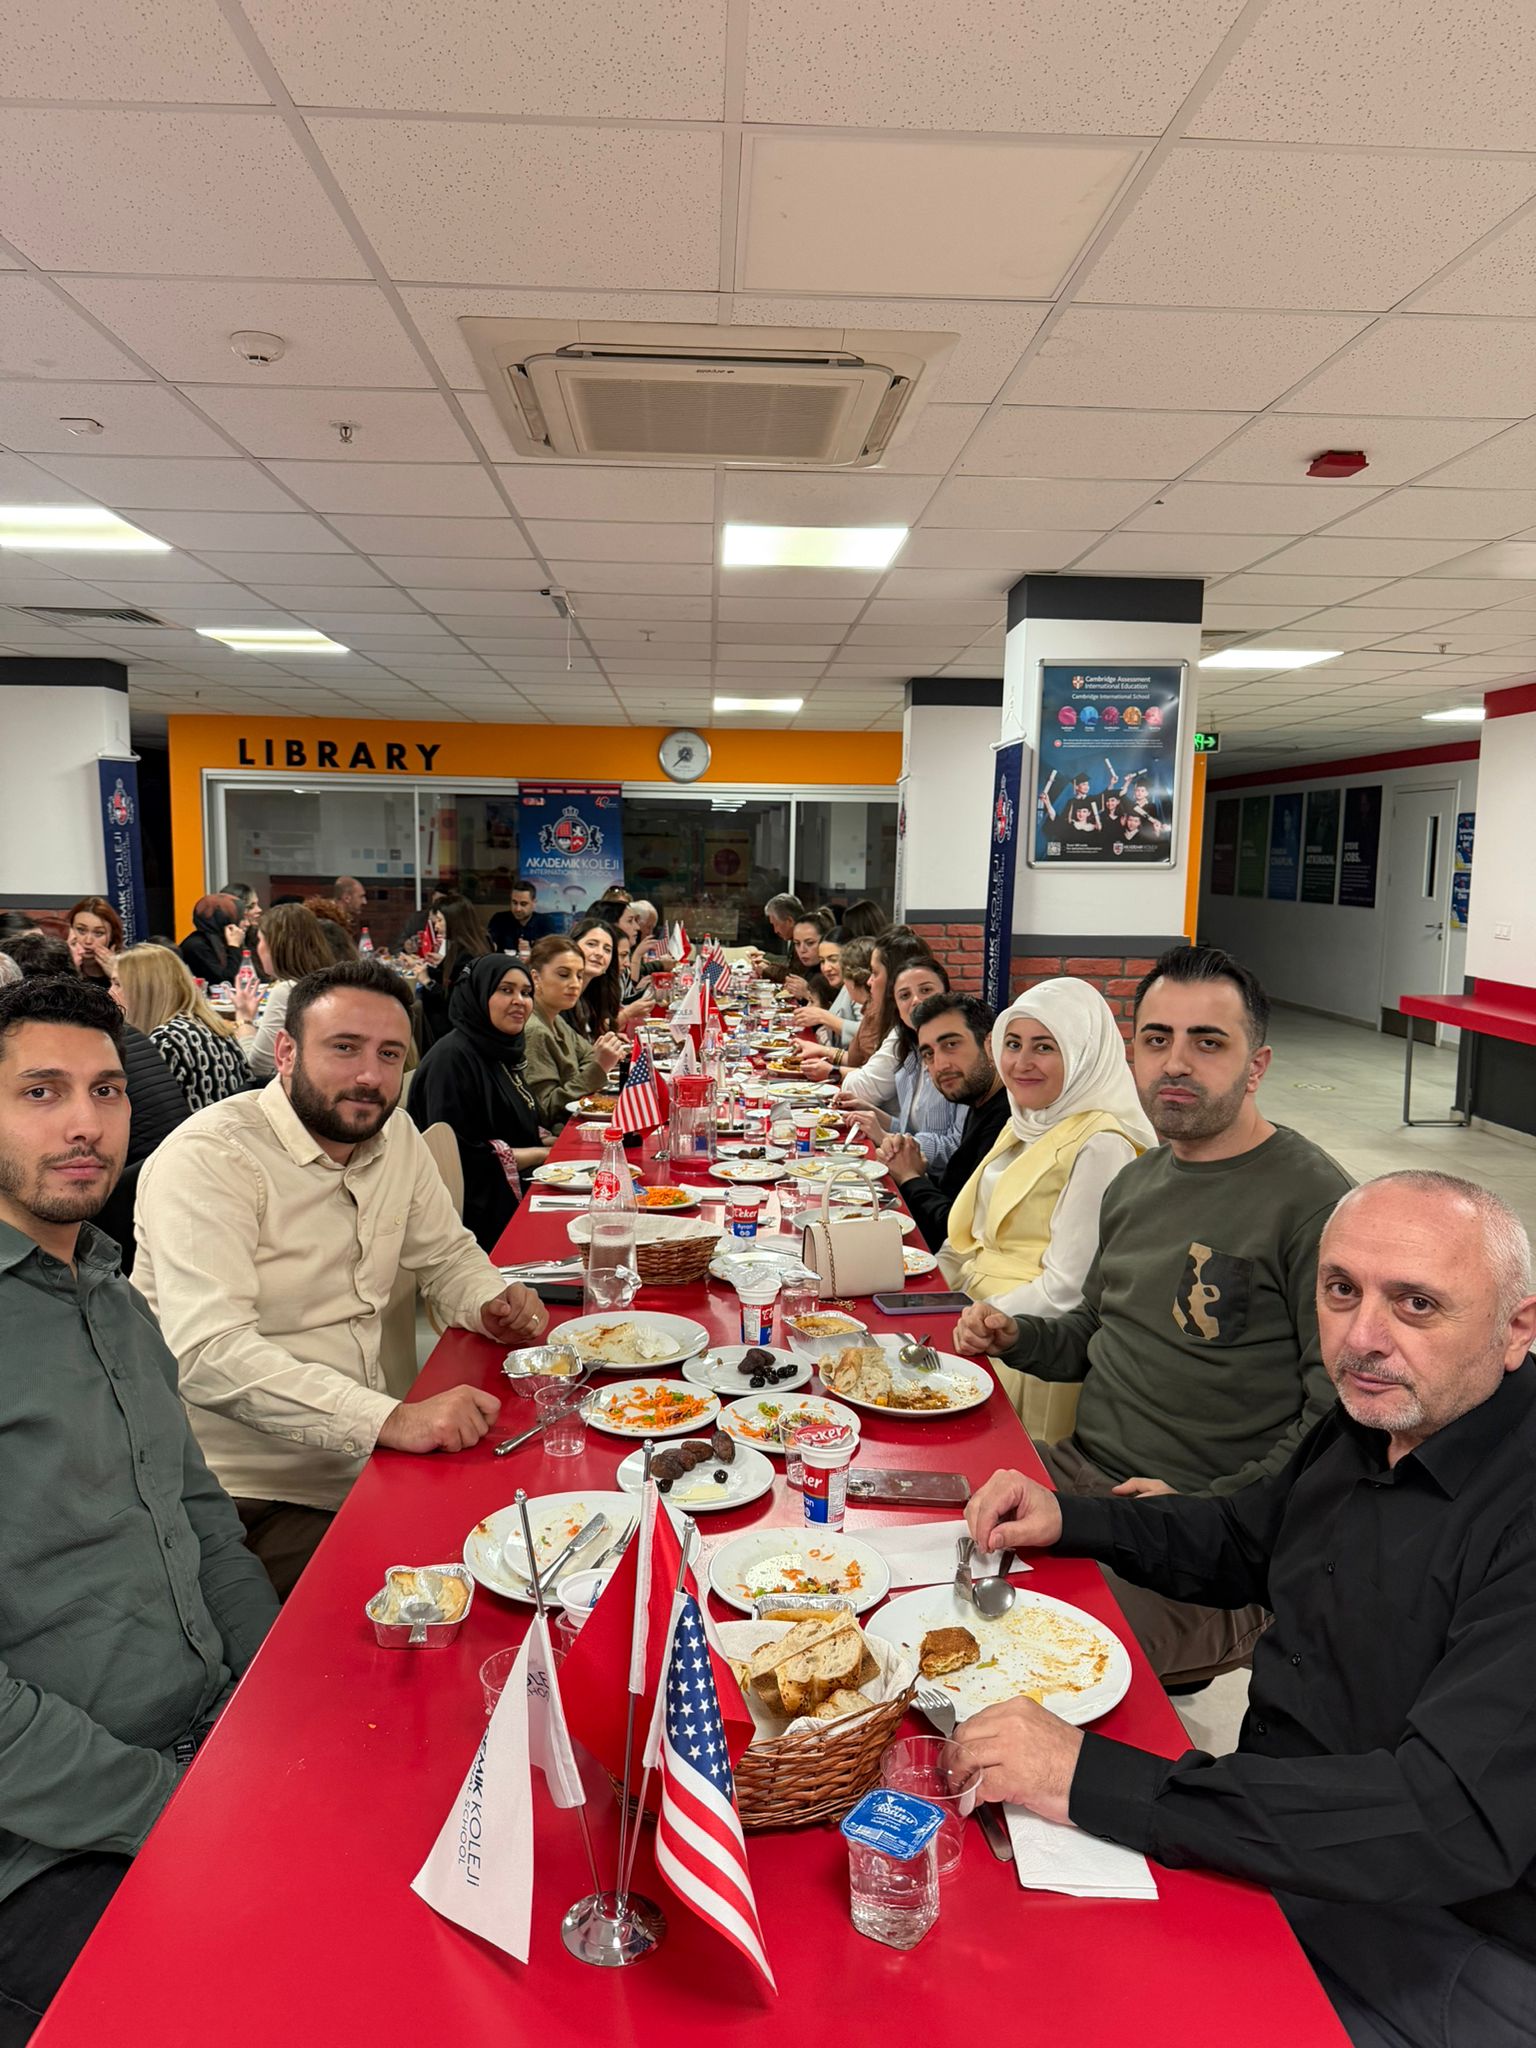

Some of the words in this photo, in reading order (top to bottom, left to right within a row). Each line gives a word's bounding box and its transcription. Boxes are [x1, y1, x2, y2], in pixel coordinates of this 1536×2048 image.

[1085, 675, 1116, 684] Cambridge
[1072, 693, 1099, 701] Cambridge
[238, 737, 442, 772] LIBRARY
[113, 832, 125, 887] KOLEJI
[526, 857, 580, 869] AKADEMIK
[582, 858, 619, 870] KOLEJI
[986, 937, 997, 1007] DEMIK
[732, 1208, 758, 1219] Teker
[803, 1469, 823, 1489] ker
[458, 1799, 471, 1865] SCHOOL
